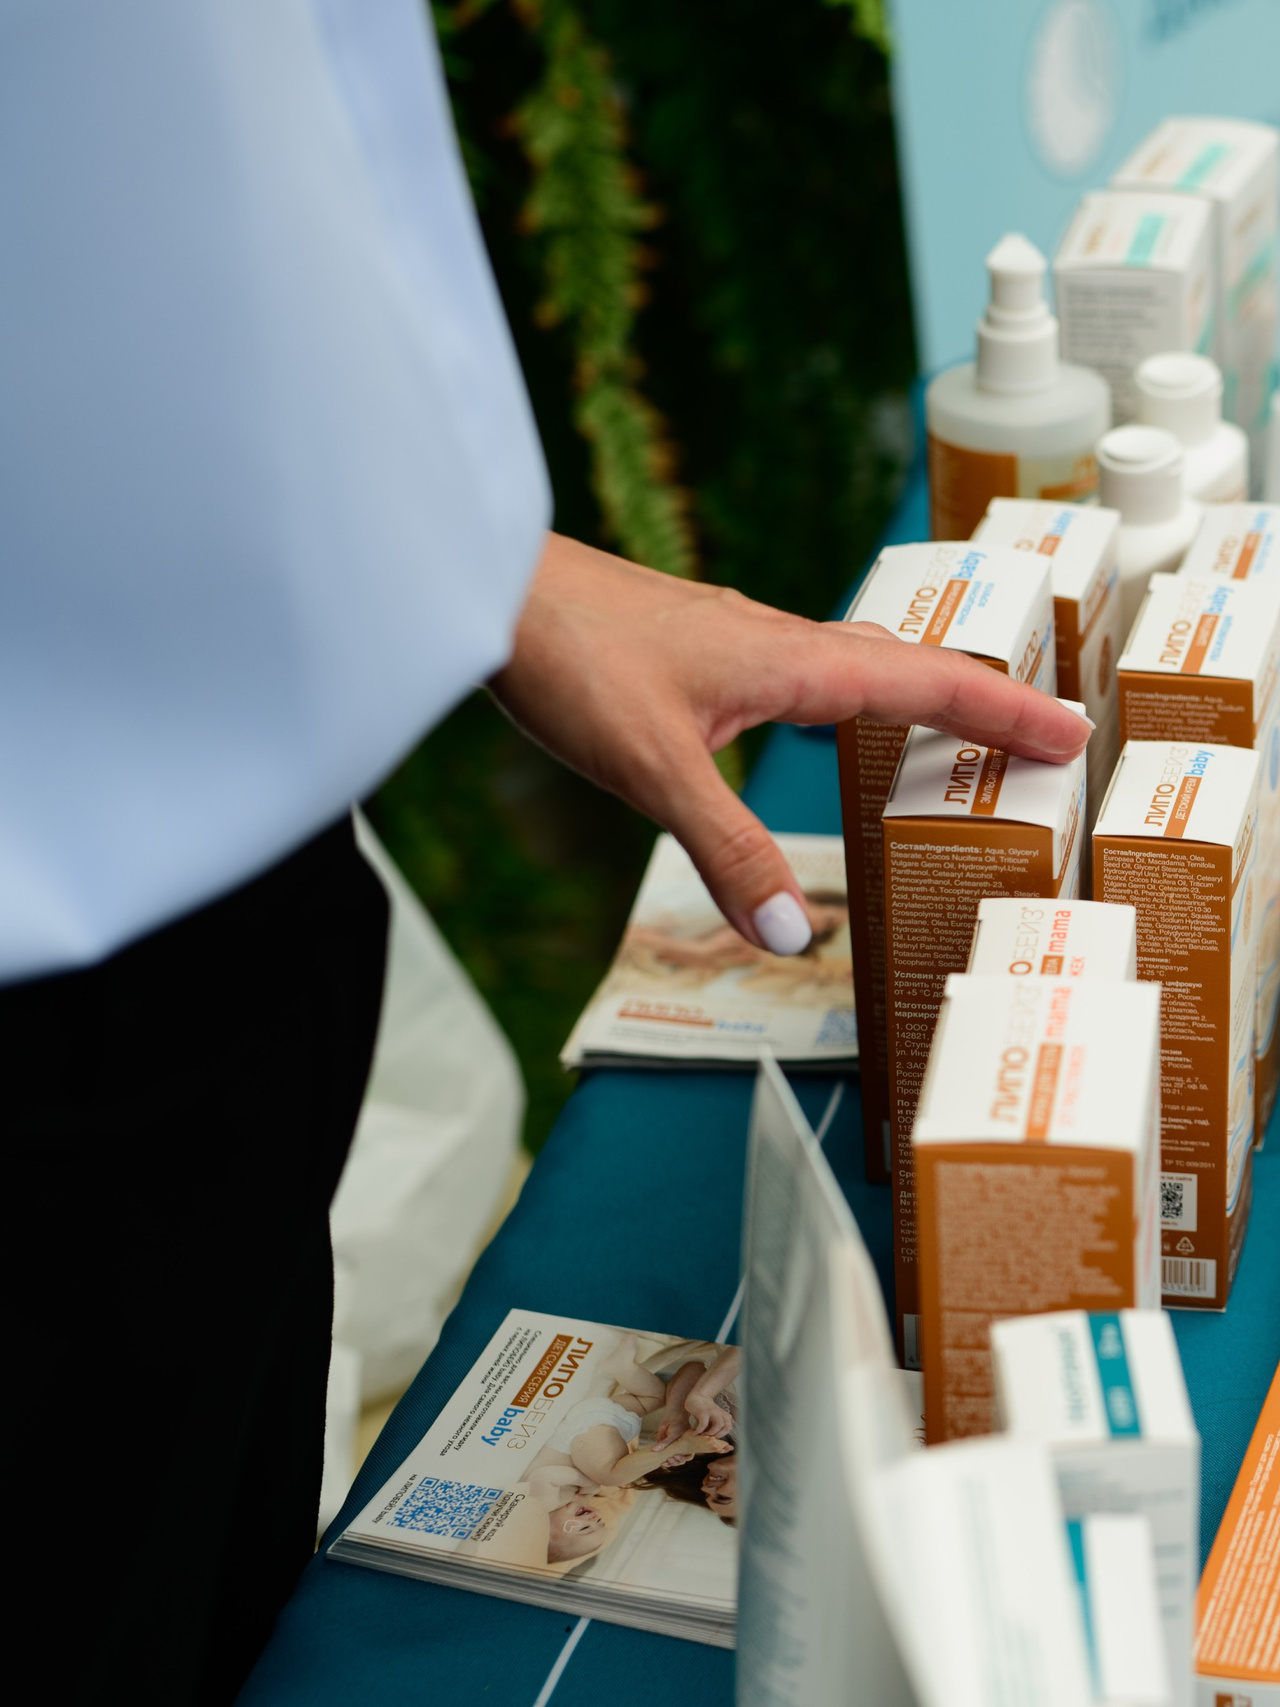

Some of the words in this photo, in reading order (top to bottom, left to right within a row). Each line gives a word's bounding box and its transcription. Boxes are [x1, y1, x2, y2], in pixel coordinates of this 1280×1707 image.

[950, 550, 988, 579] baby
[1203, 585, 1235, 614] baby
[1184, 748, 1215, 777] baby
[1144, 743, 1190, 827] ЛИПОБЕЙЗ
[1183, 776, 1198, 795] КРЕМ
[1174, 792, 1194, 822] ДЕТСКИЙ
[890, 842, 983, 854] Состав/Ingredients:
[1008, 847, 1039, 857] Glyceryl
[1103, 848, 1169, 860] Состав/Ingredients:
[890, 851, 924, 860] Stearate,
[926, 853, 950, 861] Cocos
[951, 854, 983, 862] Nucifera
[999, 856, 1029, 864] Triticum
[891, 859, 919, 869] Vulgare
[920, 861, 942, 869] Germ
[1103, 855, 1134, 863] Europaea
[1148, 858, 1185, 867] Macadamia
[891, 868, 931, 877] Panthenol,
[932, 869, 964, 879] Cetearyl
[965, 871, 995, 880] Alcohol,
[1133, 864, 1160, 872] Glyceryl
[891, 876, 952, 887] Phenoxyethanol,
[954, 879, 1005, 889] Ceteareth-23,
[1103, 880, 1127, 888] Vulgare
[1189, 880, 1214, 888] Triticum
[1196, 874, 1223, 882] Cetearyl
[912, 894, 956, 903] Rosmarinus
[939, 887, 980, 897] Tocopheryl
[982, 889, 1012, 897] Acetate,
[1014, 890, 1040, 898] Stearic
[1192, 893, 1226, 902] Tocopheryl
[891, 901, 955, 911] Acrylates/C10-30
[892, 909, 945, 920] Crosspolymer,
[892, 917, 930, 927] Squalane,
[931, 919, 949, 927] Olea
[892, 926, 932, 935] Hydroxide,
[1048, 910, 1073, 953] mama
[907, 935, 938, 943] Lecithin,
[893, 942, 918, 951] Retinyl
[893, 950, 932, 959] Potassium
[938, 961, 966, 969] Sodium
[893, 970, 934, 980] Условия
[894, 980, 929, 988] хранить
[1045, 986, 1073, 1038] mama
[895, 1032, 929, 1040] 142821,
[536, 1338, 567, 1378] ДЕТСКАЯ
[506, 1336, 594, 1450] ЛИПОБЕЙЗ
[517, 1375, 544, 1404] СЕРИЯ
[468, 1394, 486, 1414] самого
[466, 1394, 497, 1430] подготовили
[450, 1414, 472, 1439] нежного
[481, 1407, 526, 1447] baby
[452, 1430, 472, 1450] скидку
[437, 1440, 454, 1456] ухода
[383, 1481, 413, 1510] ЛИПОБЕЙЗ
[488, 1491, 515, 1516] получи
[370, 1510, 388, 1523] baby
[492, 1494, 526, 1527] Сканируй
[469, 1517, 495, 1540] скидку
